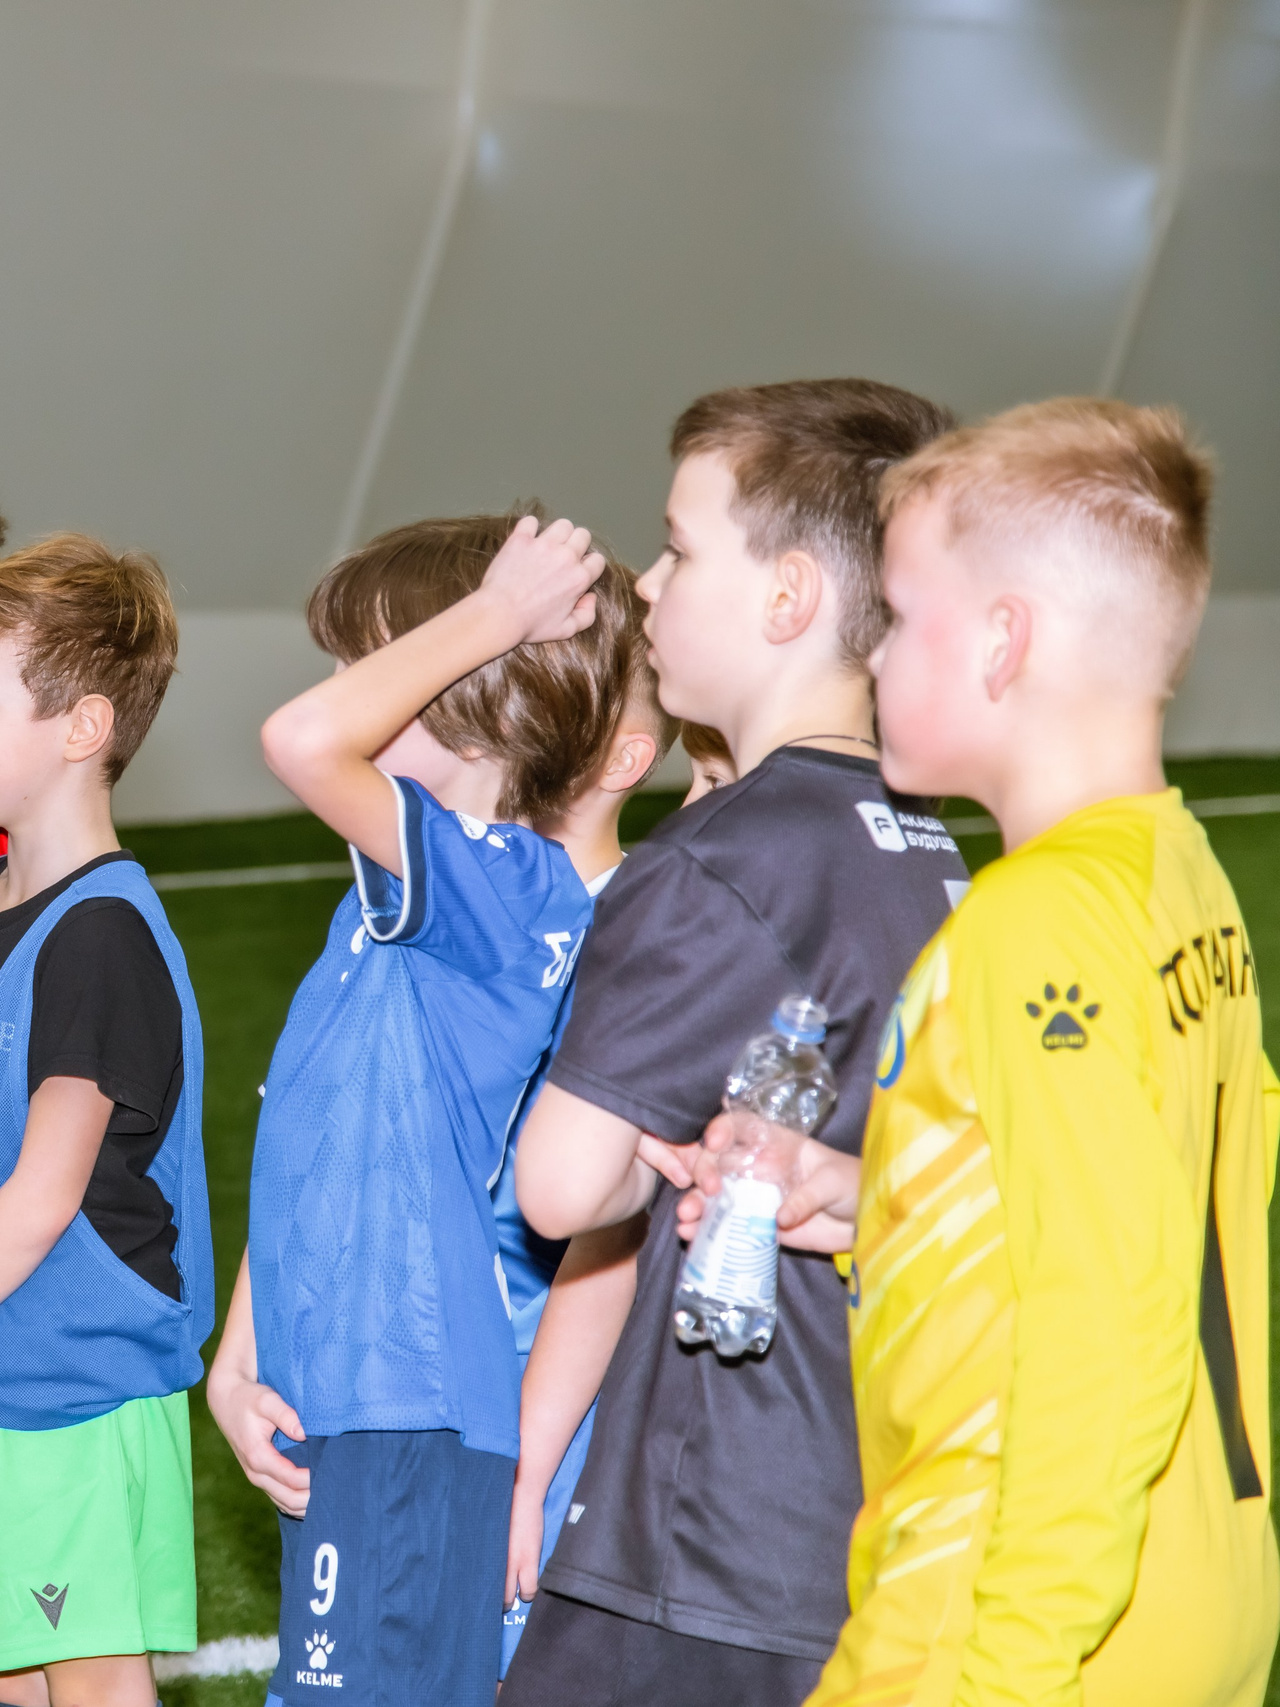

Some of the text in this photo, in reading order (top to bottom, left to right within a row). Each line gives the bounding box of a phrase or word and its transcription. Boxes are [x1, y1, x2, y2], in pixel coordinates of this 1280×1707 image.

[897, 812, 948, 833] АКАДЕ
[309, 1542, 339, 1616] 9
[296, 1670, 343, 1688] KELME
